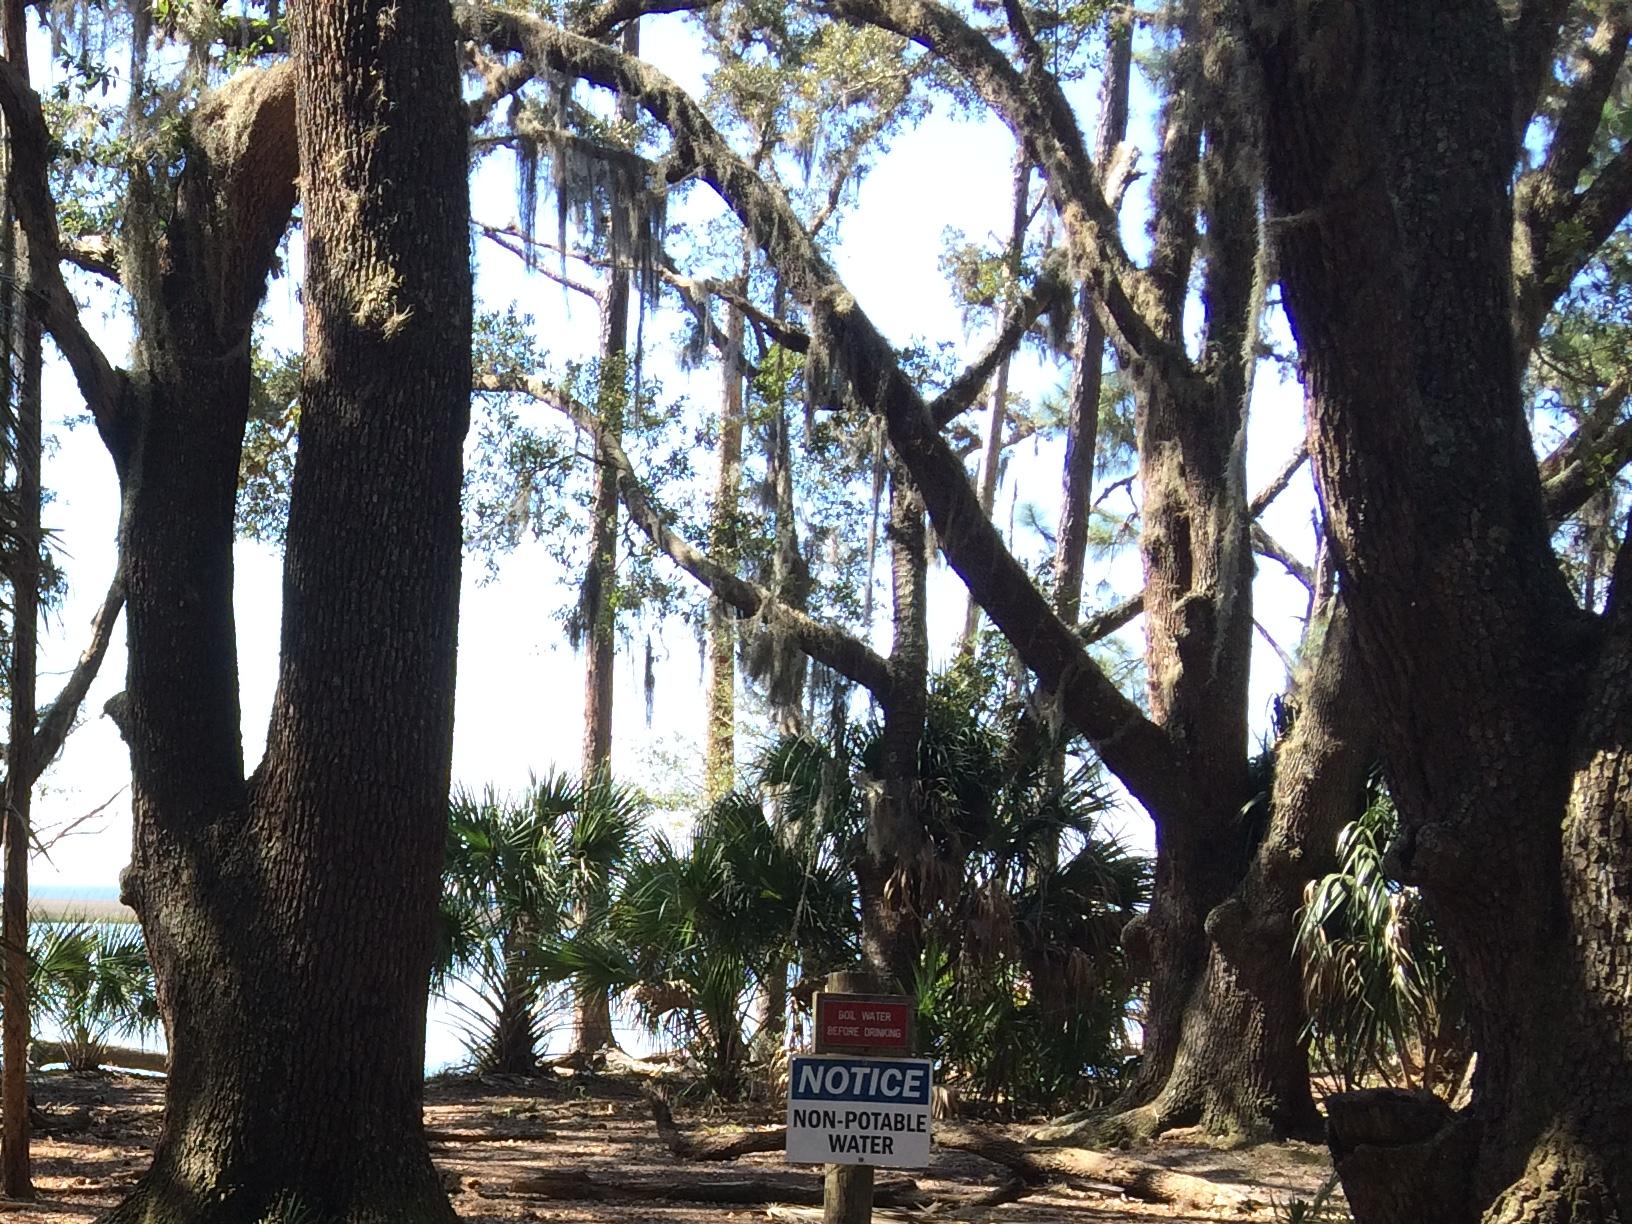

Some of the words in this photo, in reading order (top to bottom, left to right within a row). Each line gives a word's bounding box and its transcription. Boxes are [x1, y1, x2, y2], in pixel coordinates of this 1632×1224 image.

[861, 1011, 892, 1022] WATER
[827, 1026, 860, 1037] BEFORE
[864, 1027, 902, 1039] DRINKING
[798, 1065, 924, 1098] NOTICE
[793, 1109, 927, 1133] NON-POTABLE
[828, 1134, 894, 1155] WATER
